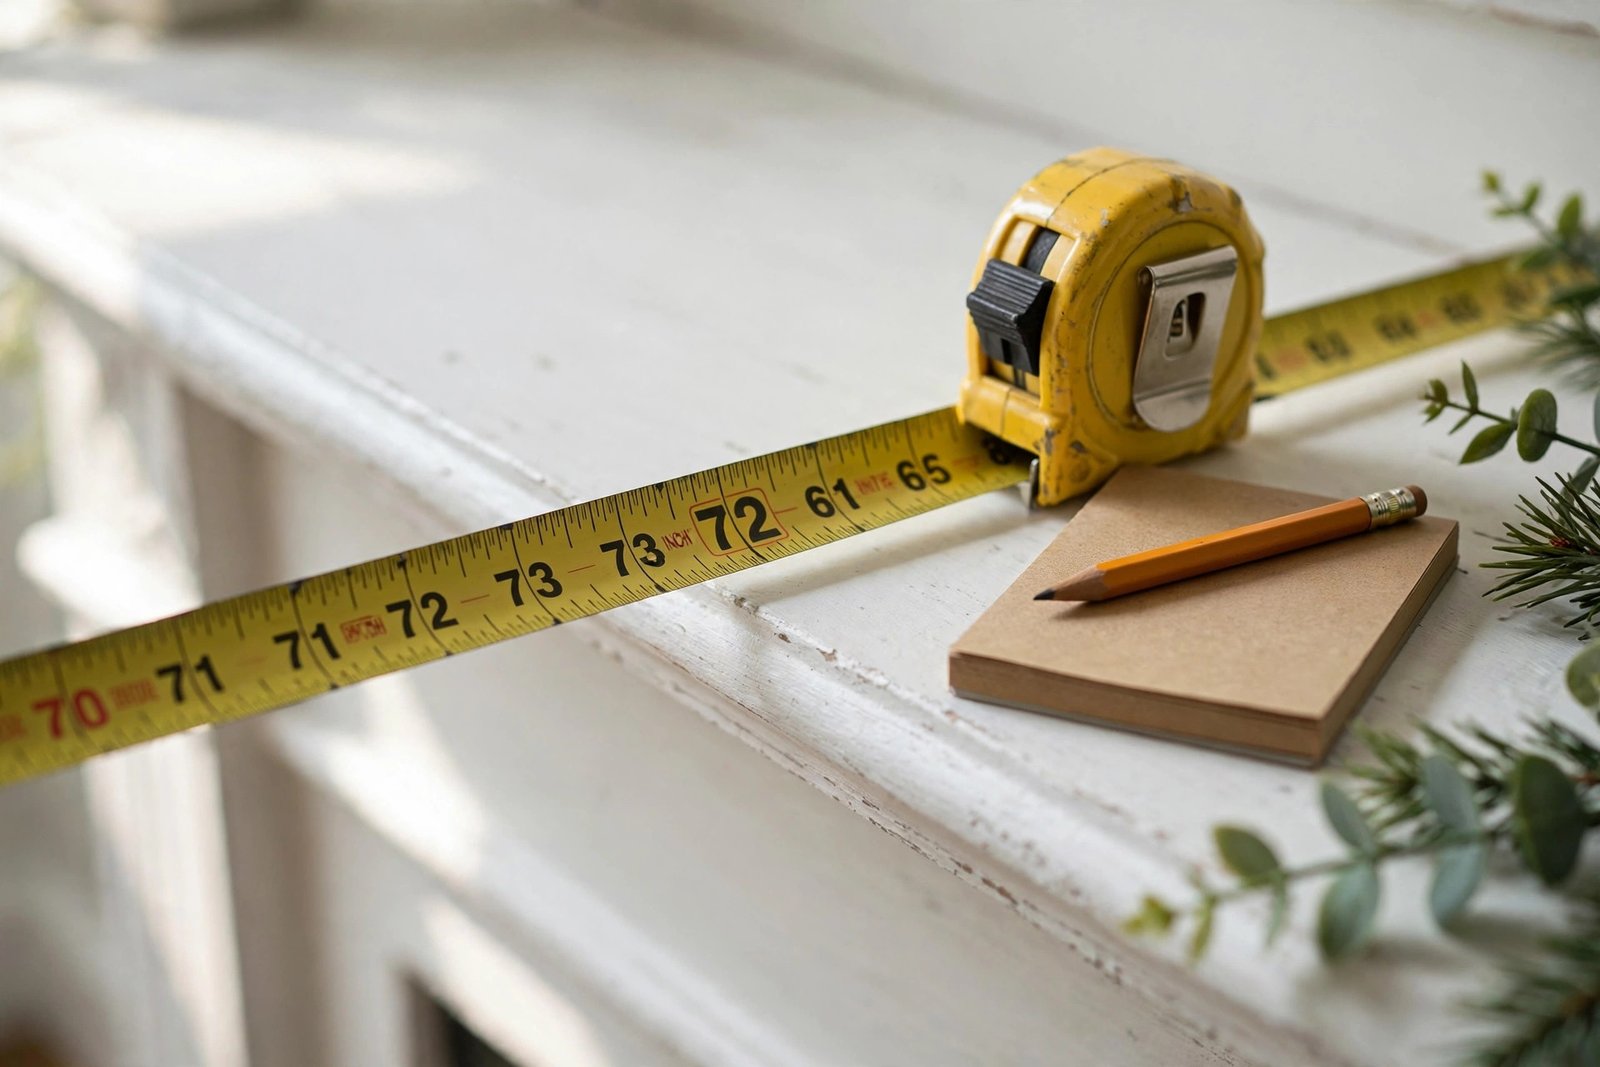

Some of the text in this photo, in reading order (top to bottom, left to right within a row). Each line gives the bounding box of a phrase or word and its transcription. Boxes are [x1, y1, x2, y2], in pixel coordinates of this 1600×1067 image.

[32, 689, 110, 739] 70
[156, 655, 224, 703] 71
[273, 623, 341, 670] 71
[385, 591, 459, 638] 72
[493, 561, 563, 607] 73
[600, 533, 665, 577] 73
[694, 496, 782, 551] 72
[805, 478, 860, 518] 61
[896, 453, 951, 491] 65
